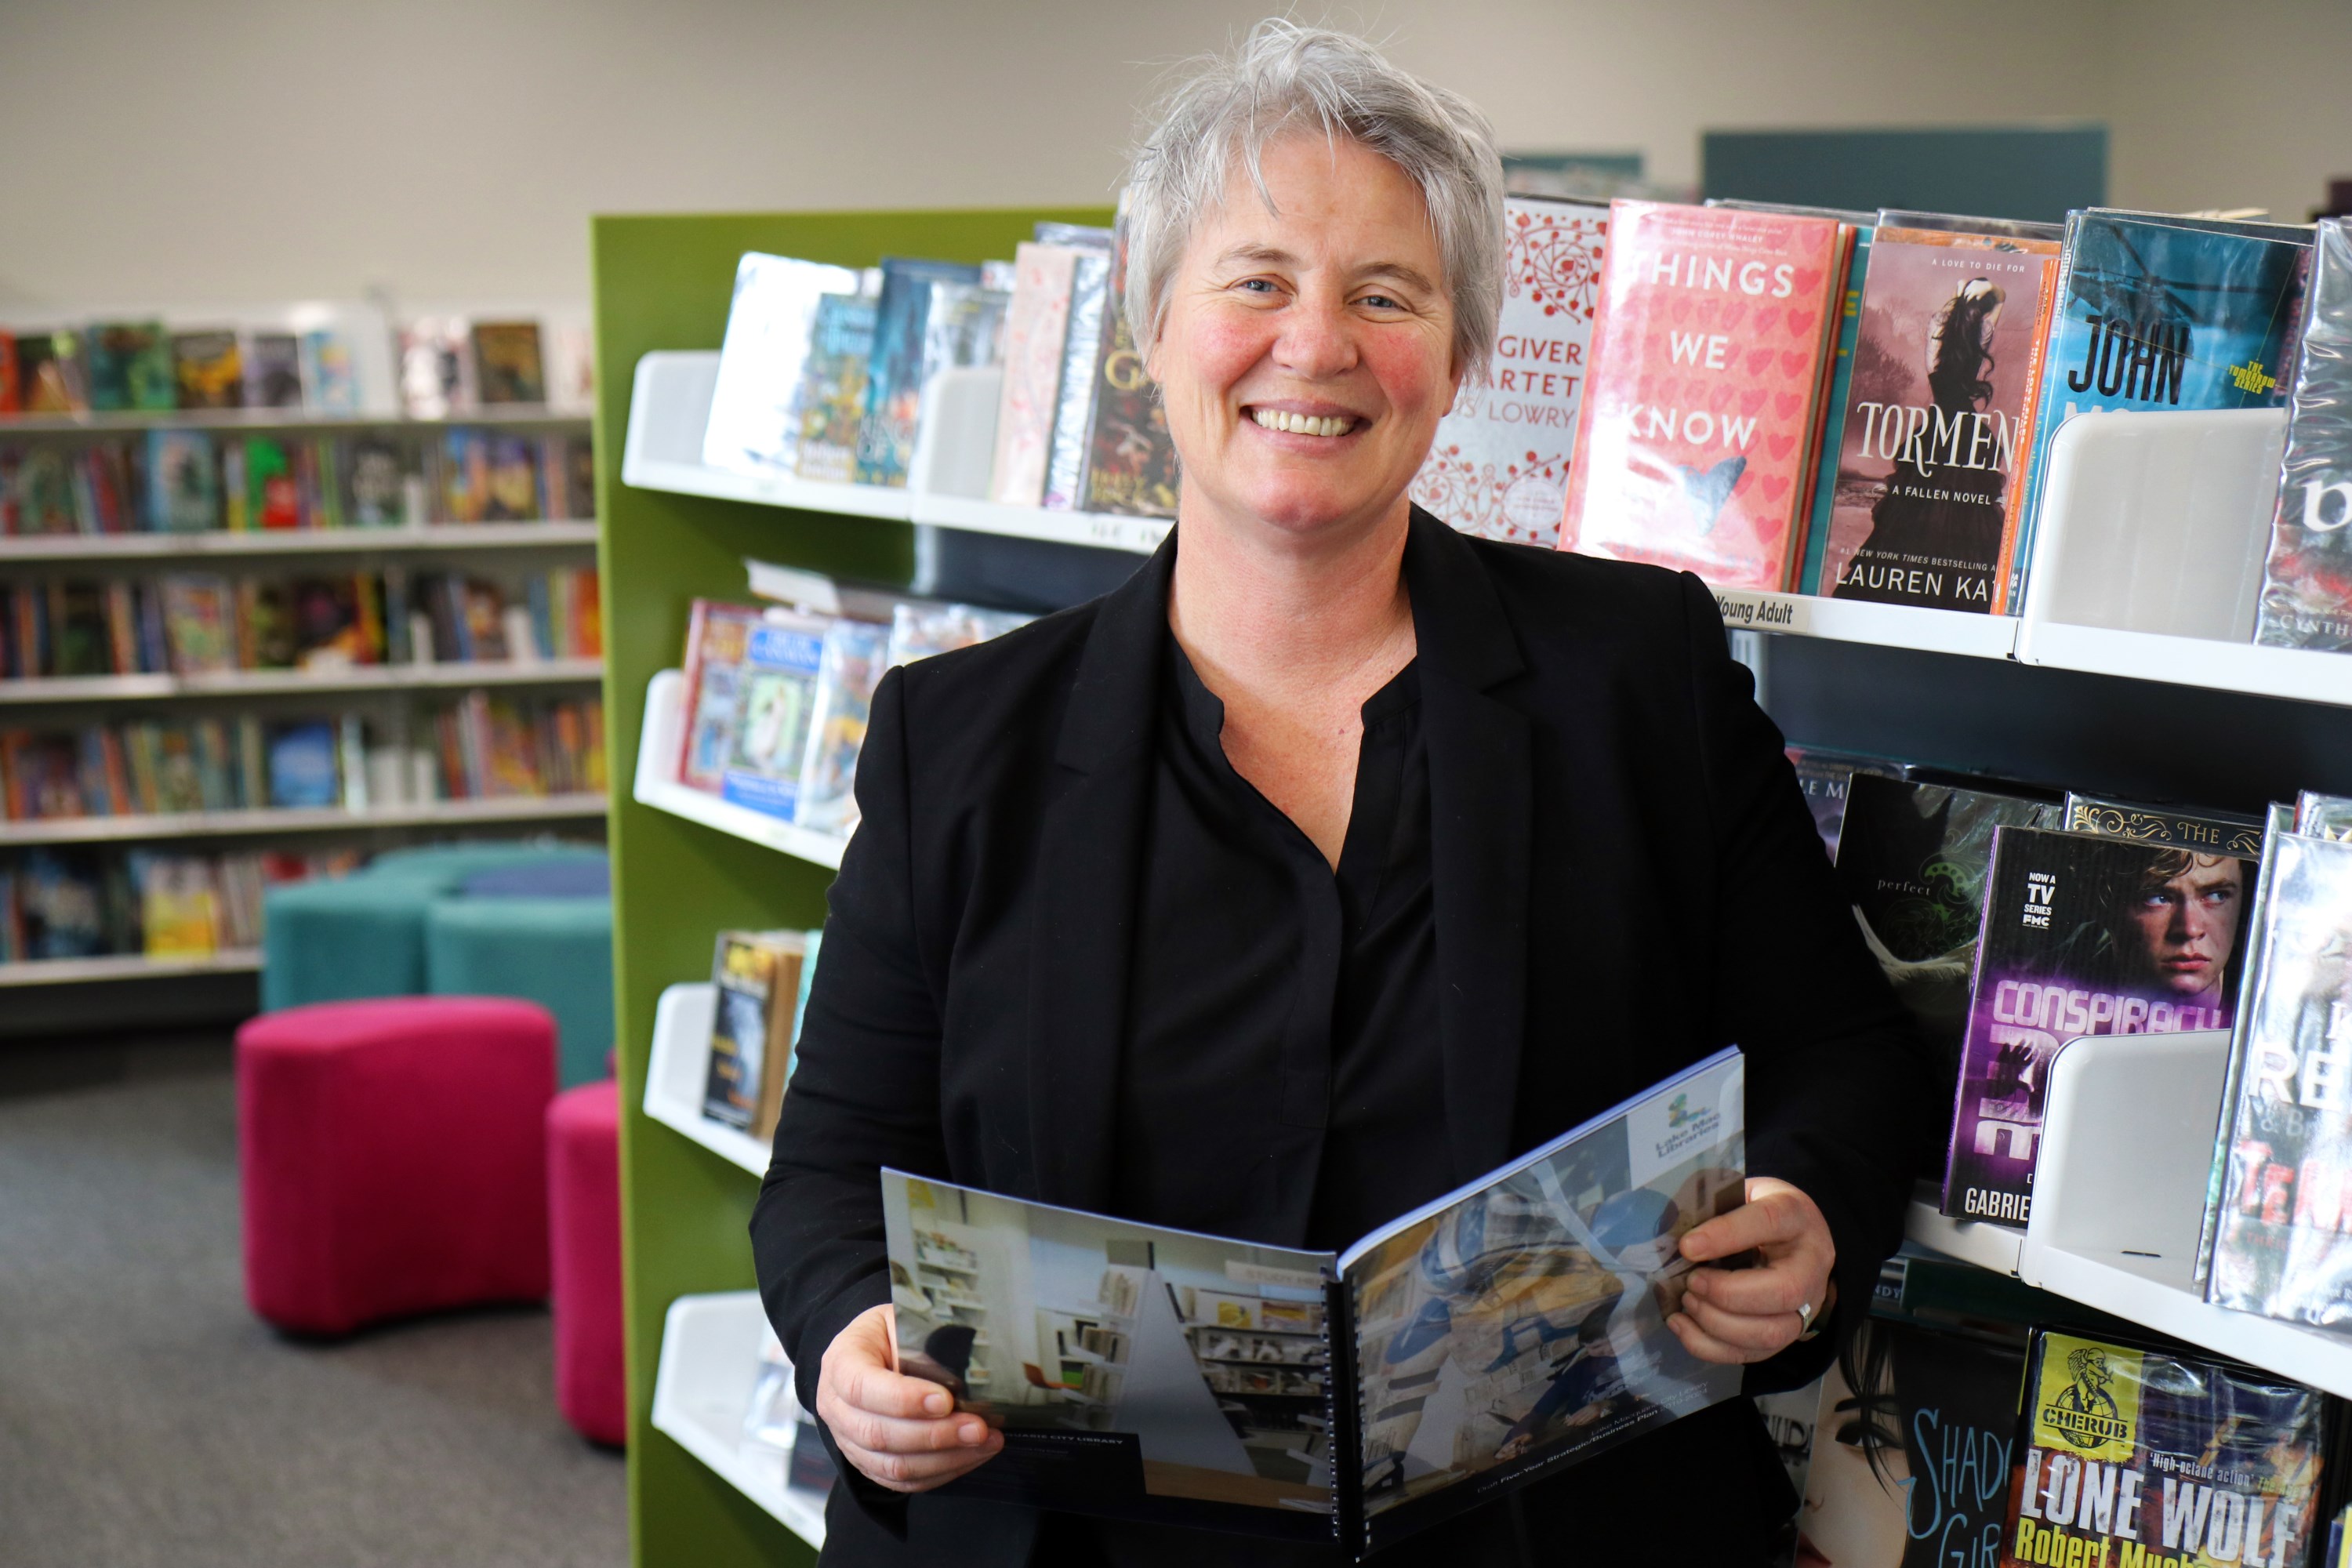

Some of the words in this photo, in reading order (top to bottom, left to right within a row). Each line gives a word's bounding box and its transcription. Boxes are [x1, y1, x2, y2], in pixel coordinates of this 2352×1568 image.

[1648, 250, 1795, 298] HINGS
[2007, 264, 2025, 273] FOR
[1497, 335, 1582, 365] GIVER
[1671, 330, 1729, 369] WE
[2067, 314, 2191, 405] JOHN
[2228, 364, 2276, 389] TOMORROW
[2248, 361, 2263, 373] THE
[2234, 378, 2264, 395] SERIES
[1488, 400, 1576, 429] LOWRY
[1622, 402, 1757, 451] KNOW
[1892, 485, 1900, 495] A
[1905, 486, 1950, 501] FALLEN
[1953, 492, 1991, 506] NOVEL
[1853, 549, 1873, 557] NEW
[1876, 550, 1899, 561] YORK
[1902, 554, 1929, 564] TIMES
[1931, 557, 1987, 572] BESTSELLING
[1835, 561, 1943, 596] LAUREN
[1955, 575, 1995, 602] KA
[1716, 595, 1754, 624] Young
[1756, 601, 1793, 625] Adult
[2177, 822, 2220, 844] THE
[1878, 879, 1931, 896] perfect
[2029, 872, 2049, 884] NOW
[2049, 875, 2056, 884] A
[2027, 883, 2055, 905] TV
[2023, 913, 2050, 927] FMC
[2024, 904, 2052, 916] SERIES
[1656, 1130, 1688, 1151] Lake
[1692, 1113, 1720, 1131] Mac
[1658, 1122, 1719, 1158] Libraries
[2043, 1408, 2128, 1439] CHERUB
[1076, 1436, 1123, 1445] LIBRARY
[1501, 1461, 1545, 1483] Five-Year
[1547, 1419, 1635, 1463] Strategic/Business
[1638, 1410, 1658, 1422] Plan
[2020, 1447, 2145, 1541] LONE
[2162, 1476, 2299, 1568] WOLF
[2014, 1517, 2111, 1568] Robert
